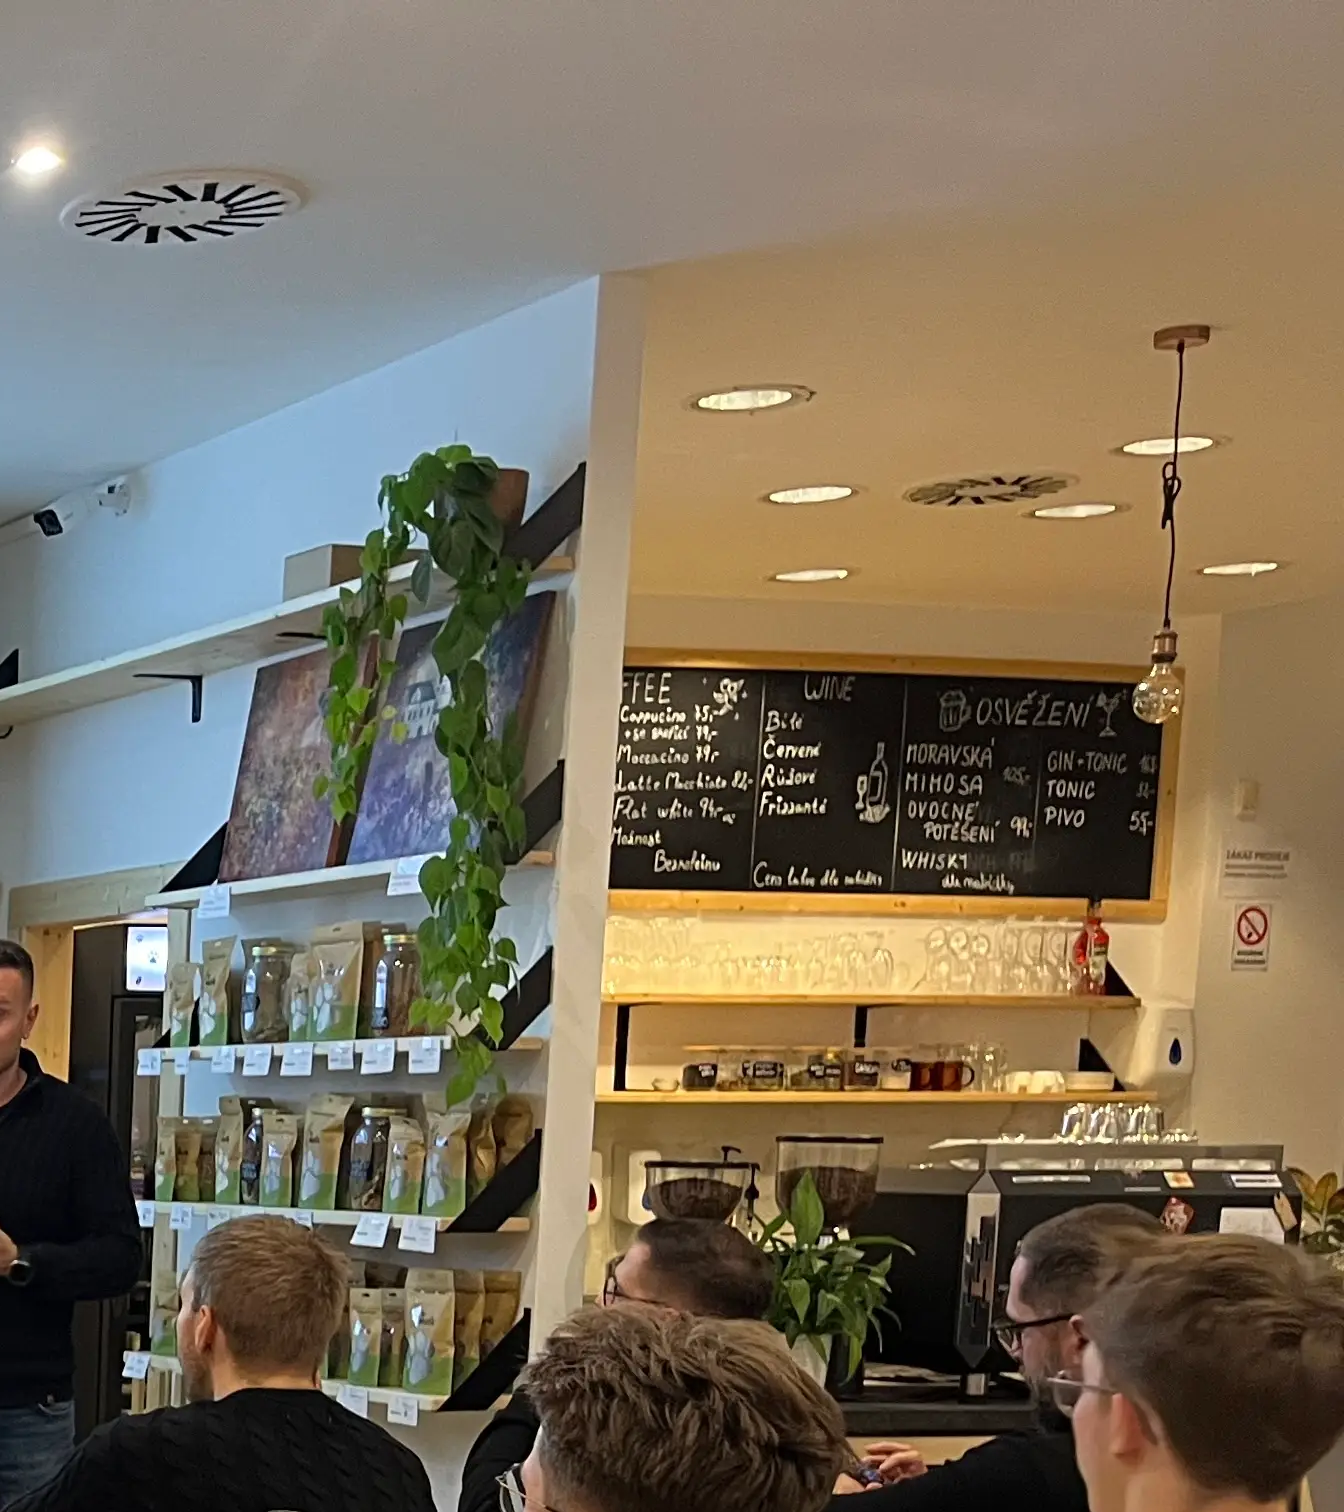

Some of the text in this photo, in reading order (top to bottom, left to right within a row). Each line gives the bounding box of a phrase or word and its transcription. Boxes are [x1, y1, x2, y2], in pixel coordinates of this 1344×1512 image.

[804, 675, 856, 701] WINE
[977, 690, 1094, 727] OSVĚŽENÍ
[763, 733, 822, 759] Červené
[906, 737, 995, 769] MORAVSKÁ
[905, 772, 983, 796] MIMOSA
[1047, 779, 1096, 800] TONIC
[908, 801, 980, 822] OVOCNÉ
[1044, 806, 1085, 829] PIVO
[902, 848, 968, 870] WHISKY
